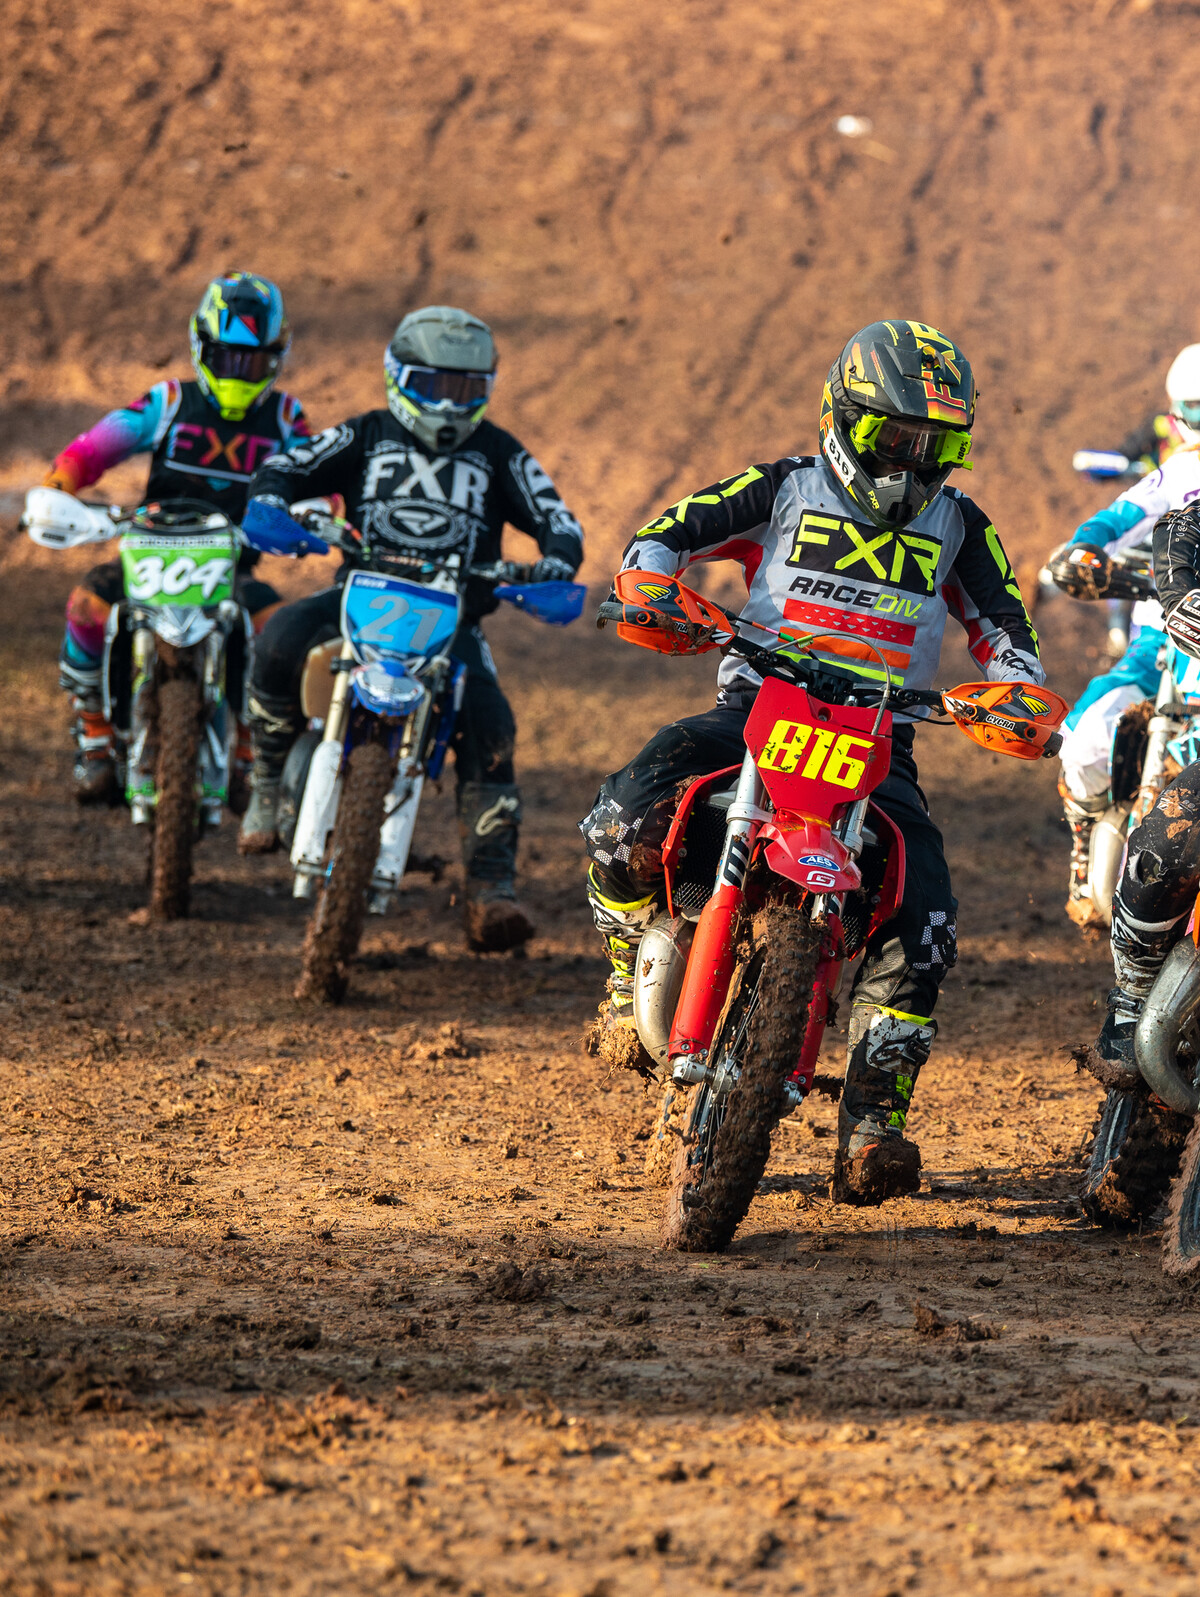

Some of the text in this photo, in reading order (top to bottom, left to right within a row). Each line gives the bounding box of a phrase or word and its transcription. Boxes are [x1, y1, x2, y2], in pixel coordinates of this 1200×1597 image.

[829, 438, 849, 476] 816
[957, 440, 969, 461] 100%
[362, 451, 489, 518] FXR
[867, 490, 880, 510] FXR
[789, 514, 942, 592] FXR
[129, 556, 234, 600] 304
[357, 594, 443, 651] 21
[986, 714, 1015, 730] CYCRA
[757, 719, 876, 790] 816
[806, 855, 832, 867] AES
